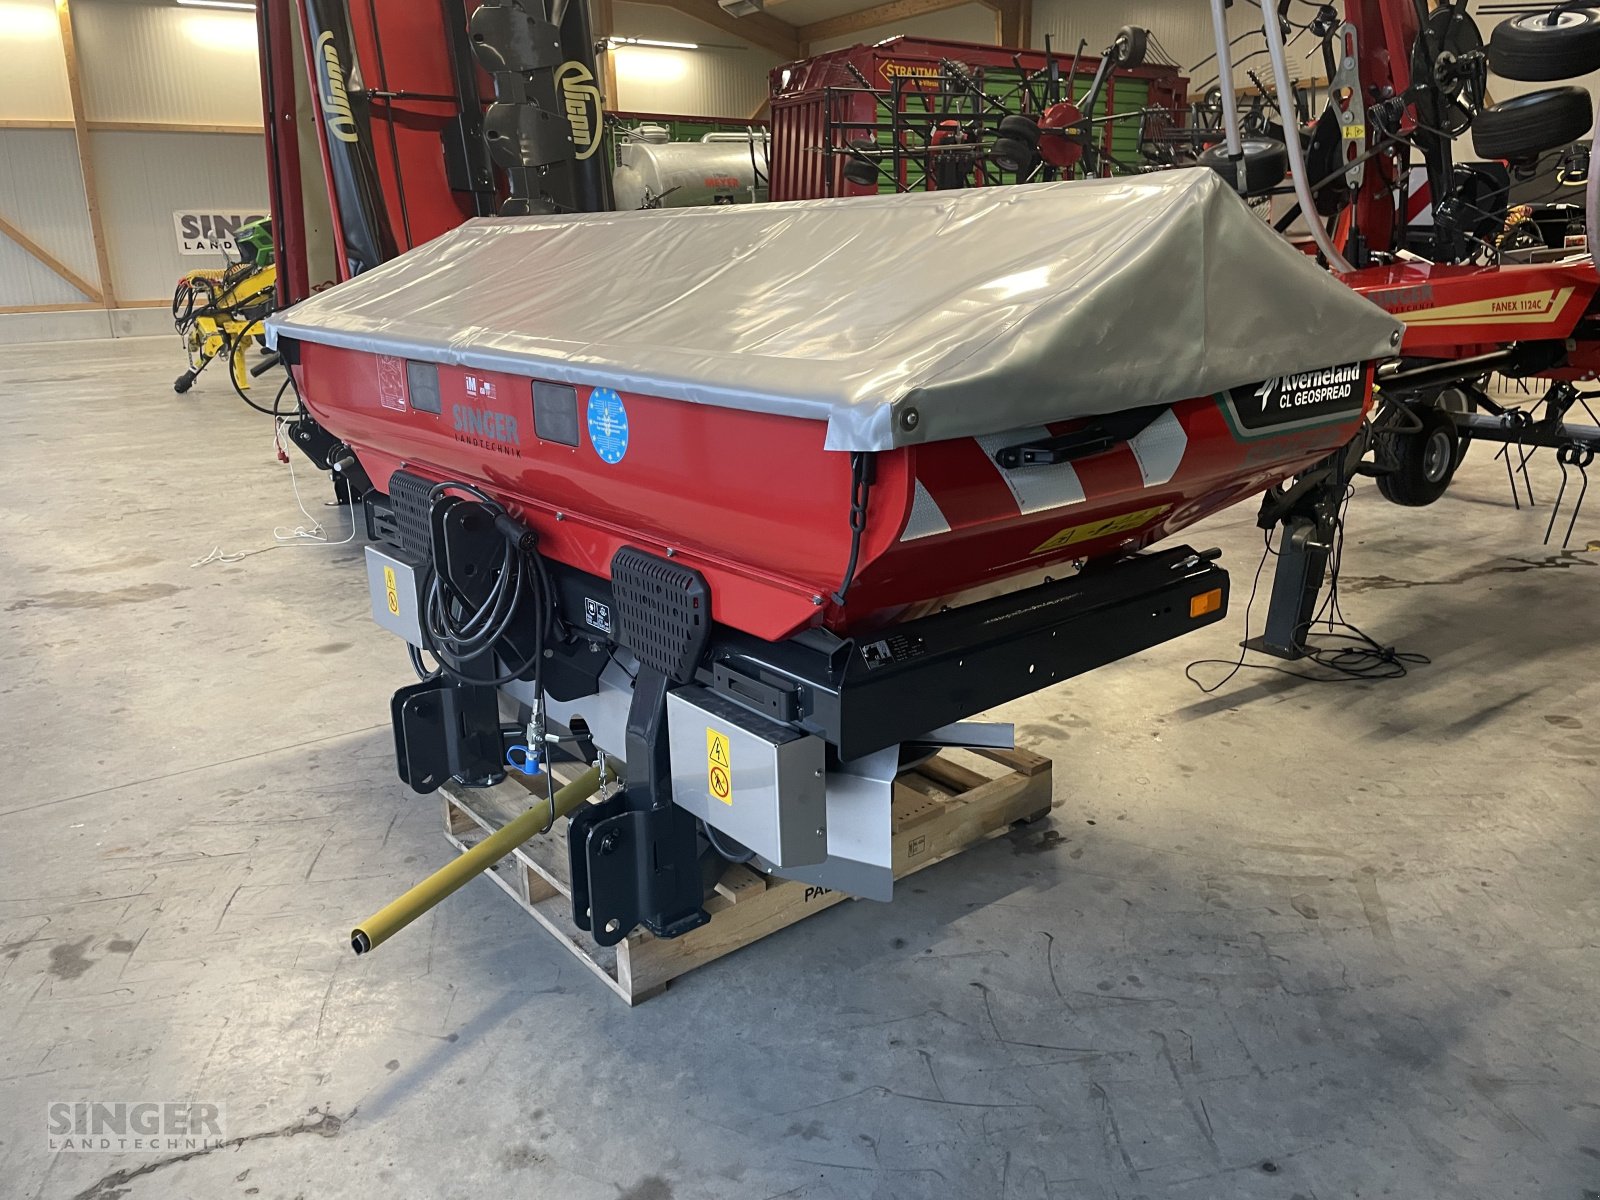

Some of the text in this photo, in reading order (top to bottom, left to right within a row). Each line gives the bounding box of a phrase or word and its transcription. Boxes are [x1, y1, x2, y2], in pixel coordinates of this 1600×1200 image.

[554, 60, 603, 160] Vicon
[1491, 300, 1542, 312] FANEX 1124C
[1280, 383, 1351, 409] CL GEOSPREAD
[452, 403, 520, 446] SINGER
[454, 433, 522, 458] LANDTECHNIK
